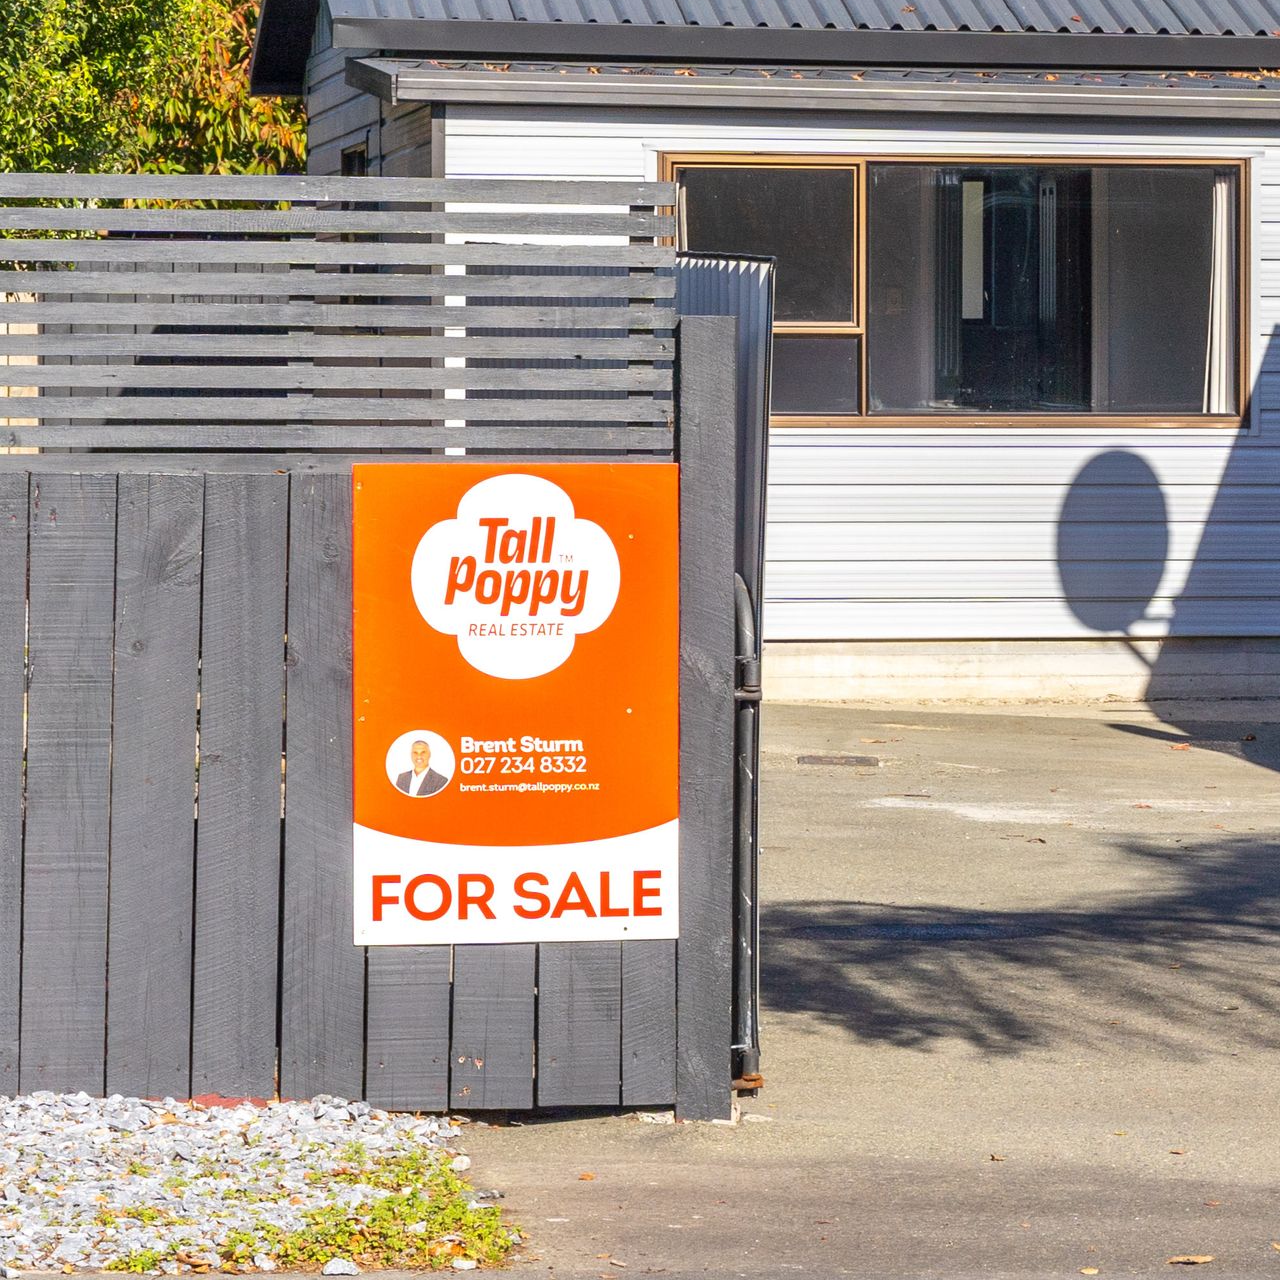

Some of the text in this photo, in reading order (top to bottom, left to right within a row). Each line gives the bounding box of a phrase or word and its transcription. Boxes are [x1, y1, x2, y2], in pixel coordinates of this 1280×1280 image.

[479, 516, 556, 564] Tall
[468, 622, 564, 637] REAL ESTATE
[460, 735, 584, 753] Brent Sturm
[460, 755, 587, 774] 027 234 8332
[459, 782, 600, 793] brent.sturm@tallpoppy.co.nz
[372, 870, 662, 921] FOR SALE
